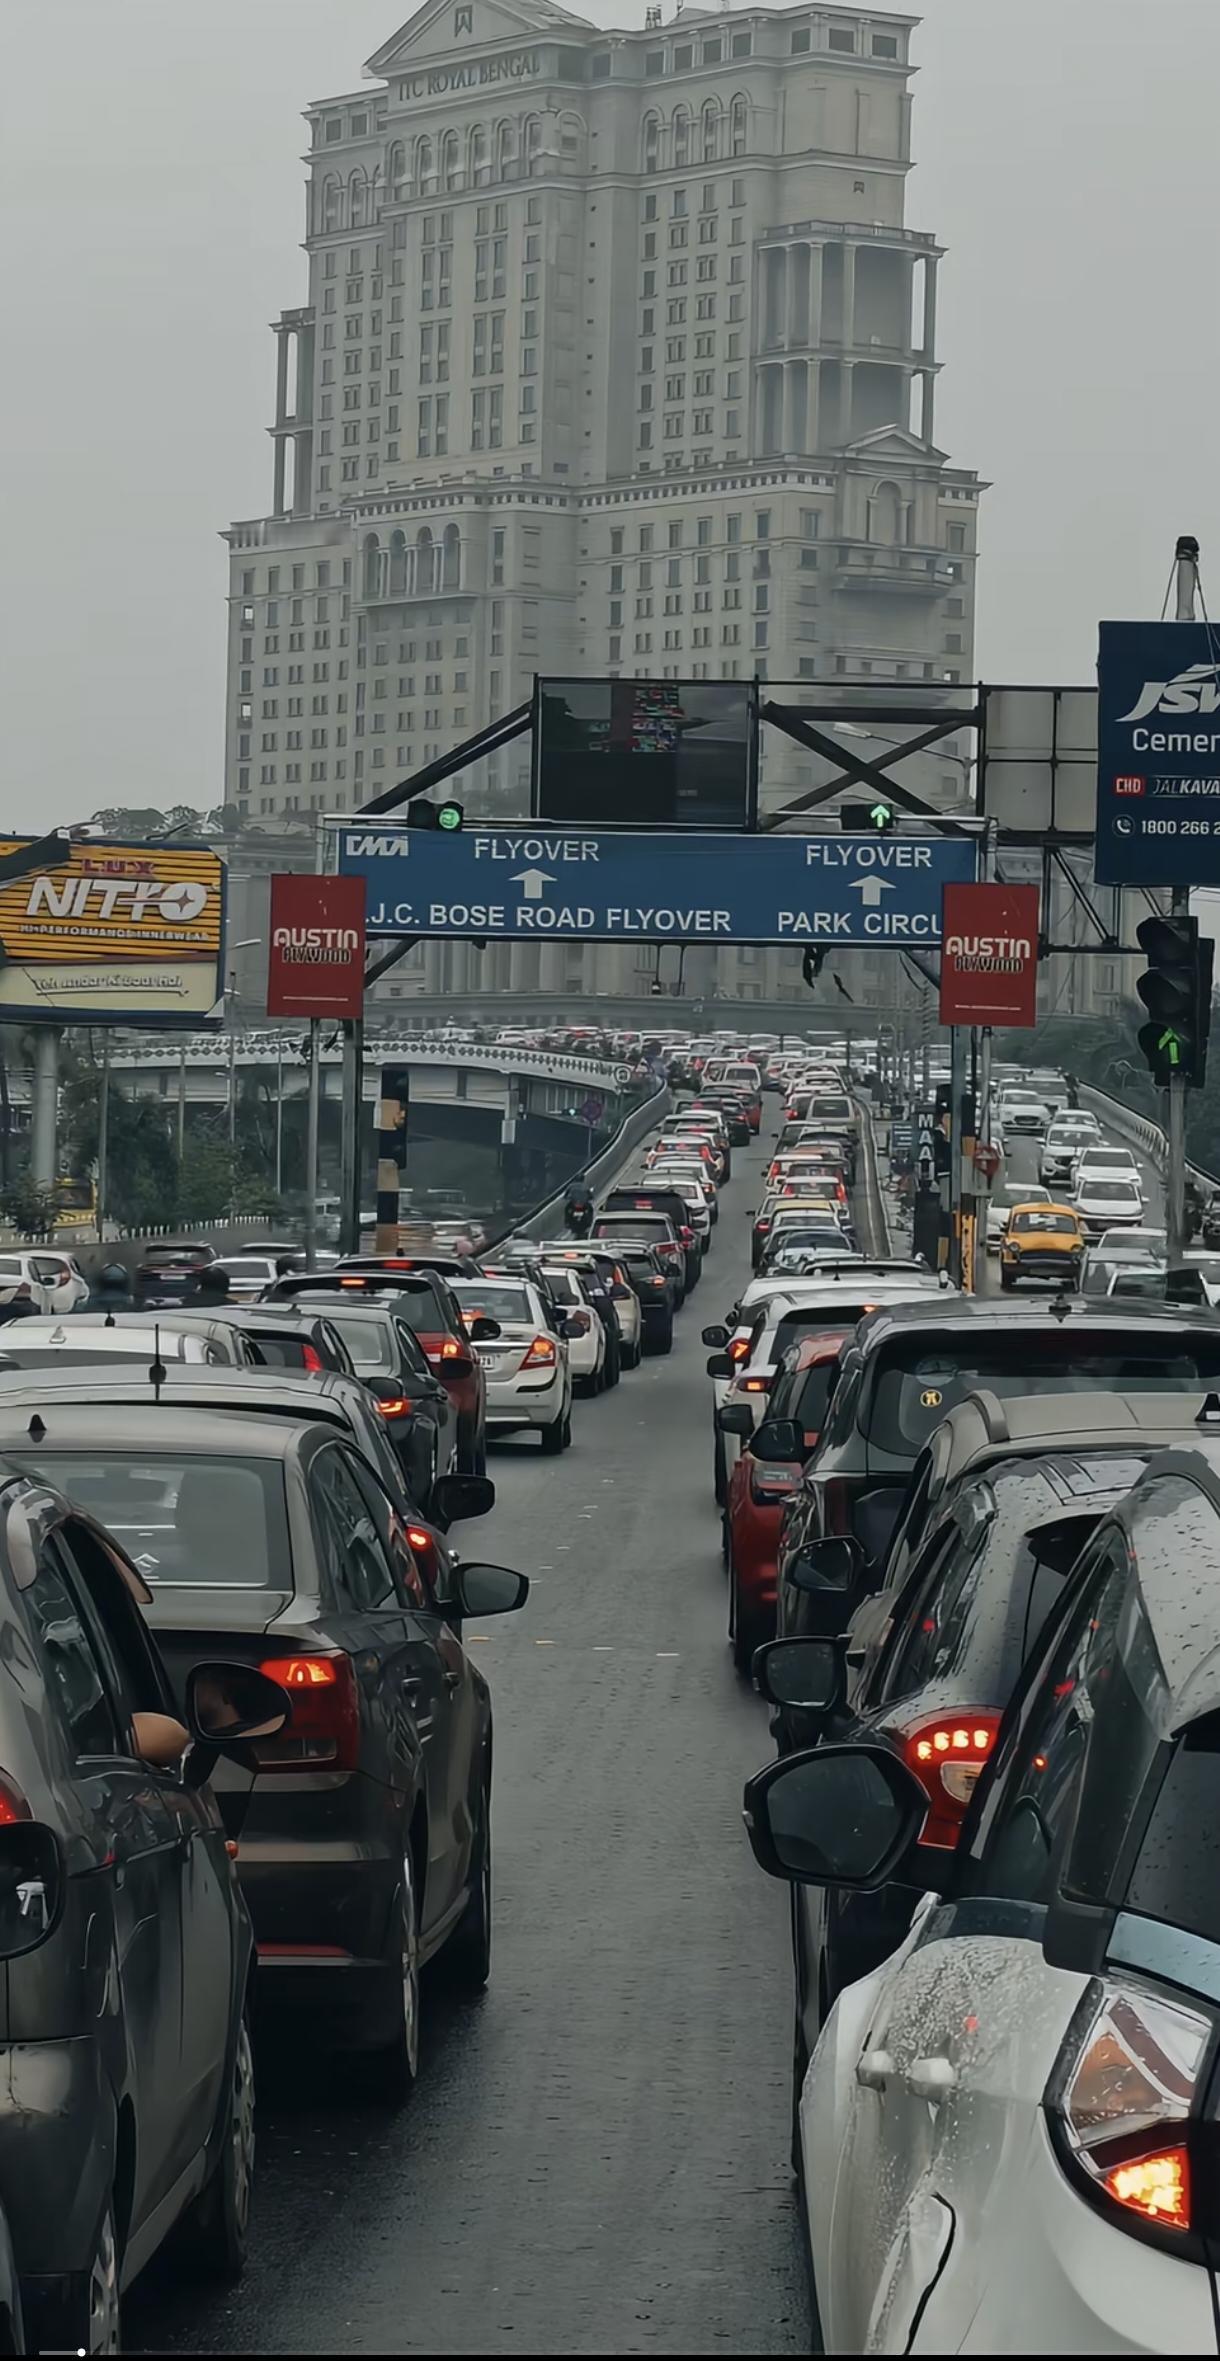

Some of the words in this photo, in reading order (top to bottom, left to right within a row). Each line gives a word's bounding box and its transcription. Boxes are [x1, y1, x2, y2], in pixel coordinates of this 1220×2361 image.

[399, 78, 423, 101] ITC
[427, 67, 477, 95] ROYAL
[479, 55, 541, 84] BENGAL
[1116, 778, 1141, 793] CHD
[1141, 820, 1177, 834] 1800
[1180, 821, 1210, 835] 266
[475, 838, 600, 862] FLYOVER
[806, 844, 933, 868] FLYOVER
[82, 859, 155, 875] LUX
[430, 904, 505, 927] BOSE
[516, 906, 596, 929] ROAD
[606, 908, 732, 932] FLYOVER
[778, 911, 852, 934] PARK
[273, 927, 358, 949] AUSTIN
[946, 936, 1031, 959] AUSTIN
